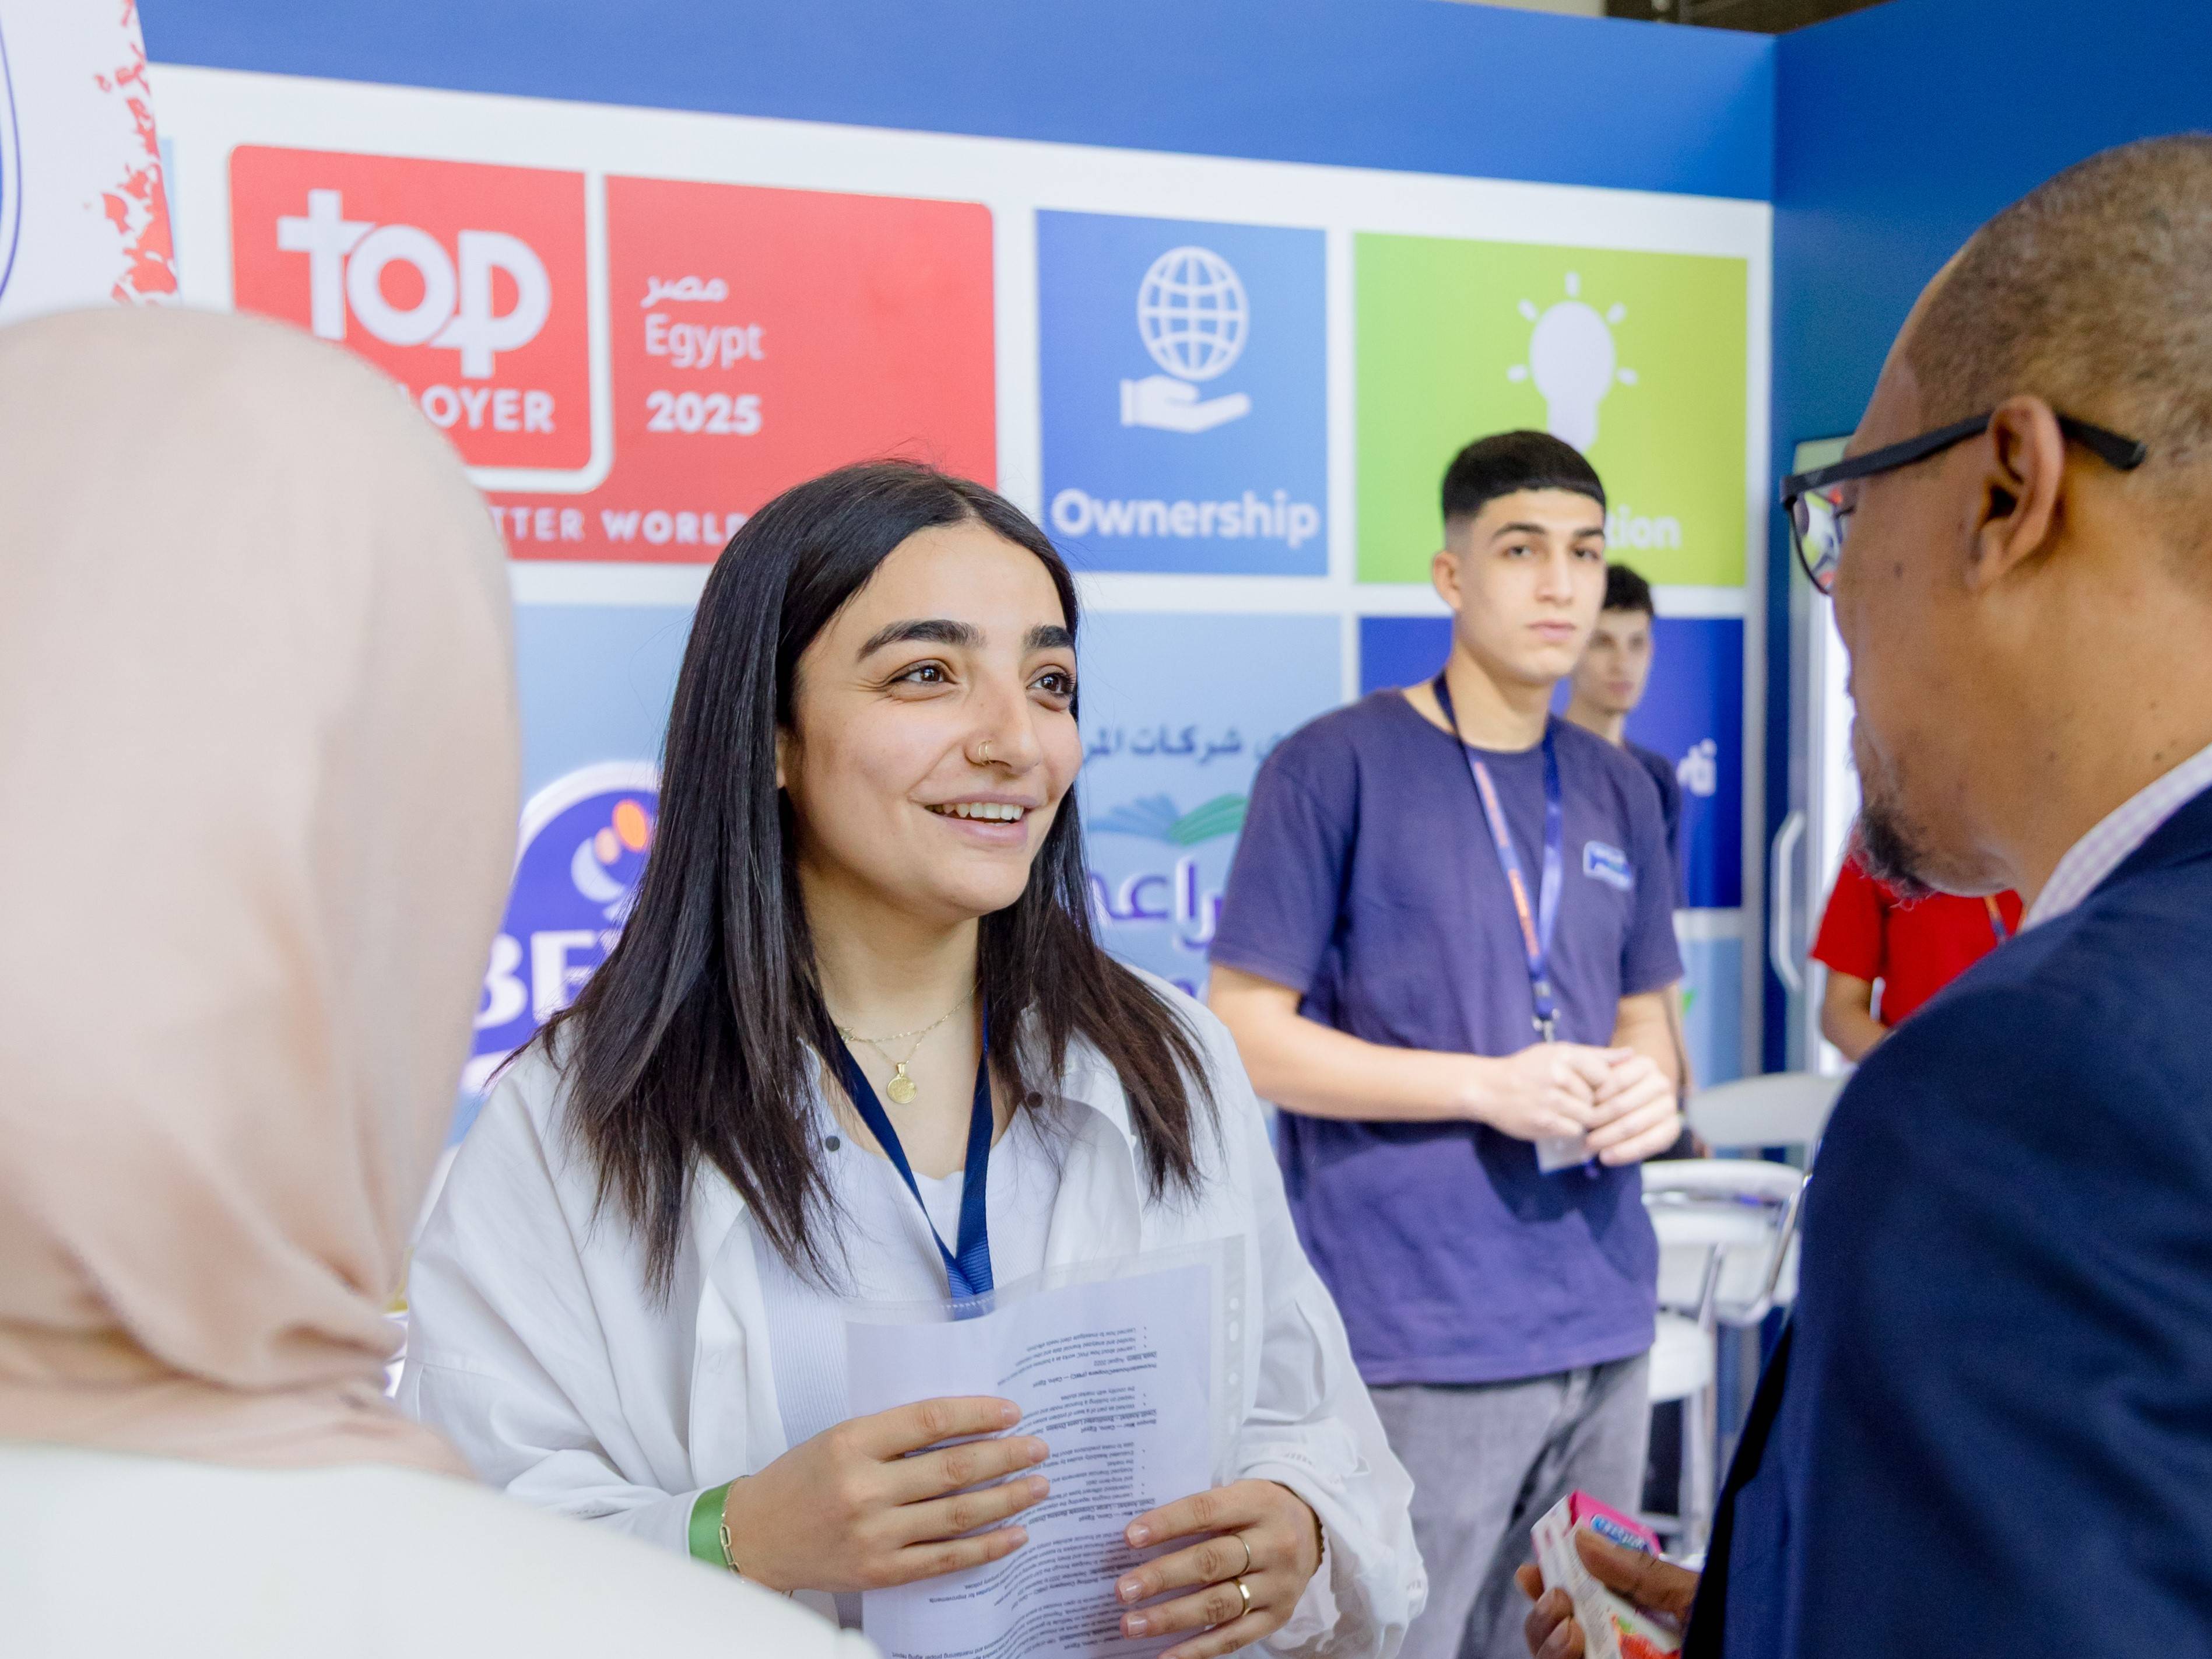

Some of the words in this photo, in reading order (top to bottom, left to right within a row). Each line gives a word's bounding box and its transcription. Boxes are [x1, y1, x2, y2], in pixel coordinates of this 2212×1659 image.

[640, 275, 728, 308] مصر
[645, 313, 765, 370] Egypt
[417, 384, 556, 434] OYER
[645, 390, 763, 436] 2025
[490, 505, 585, 542] TTER
[1050, 487, 1321, 549] Ownership
[1605, 503, 1683, 550] tion
